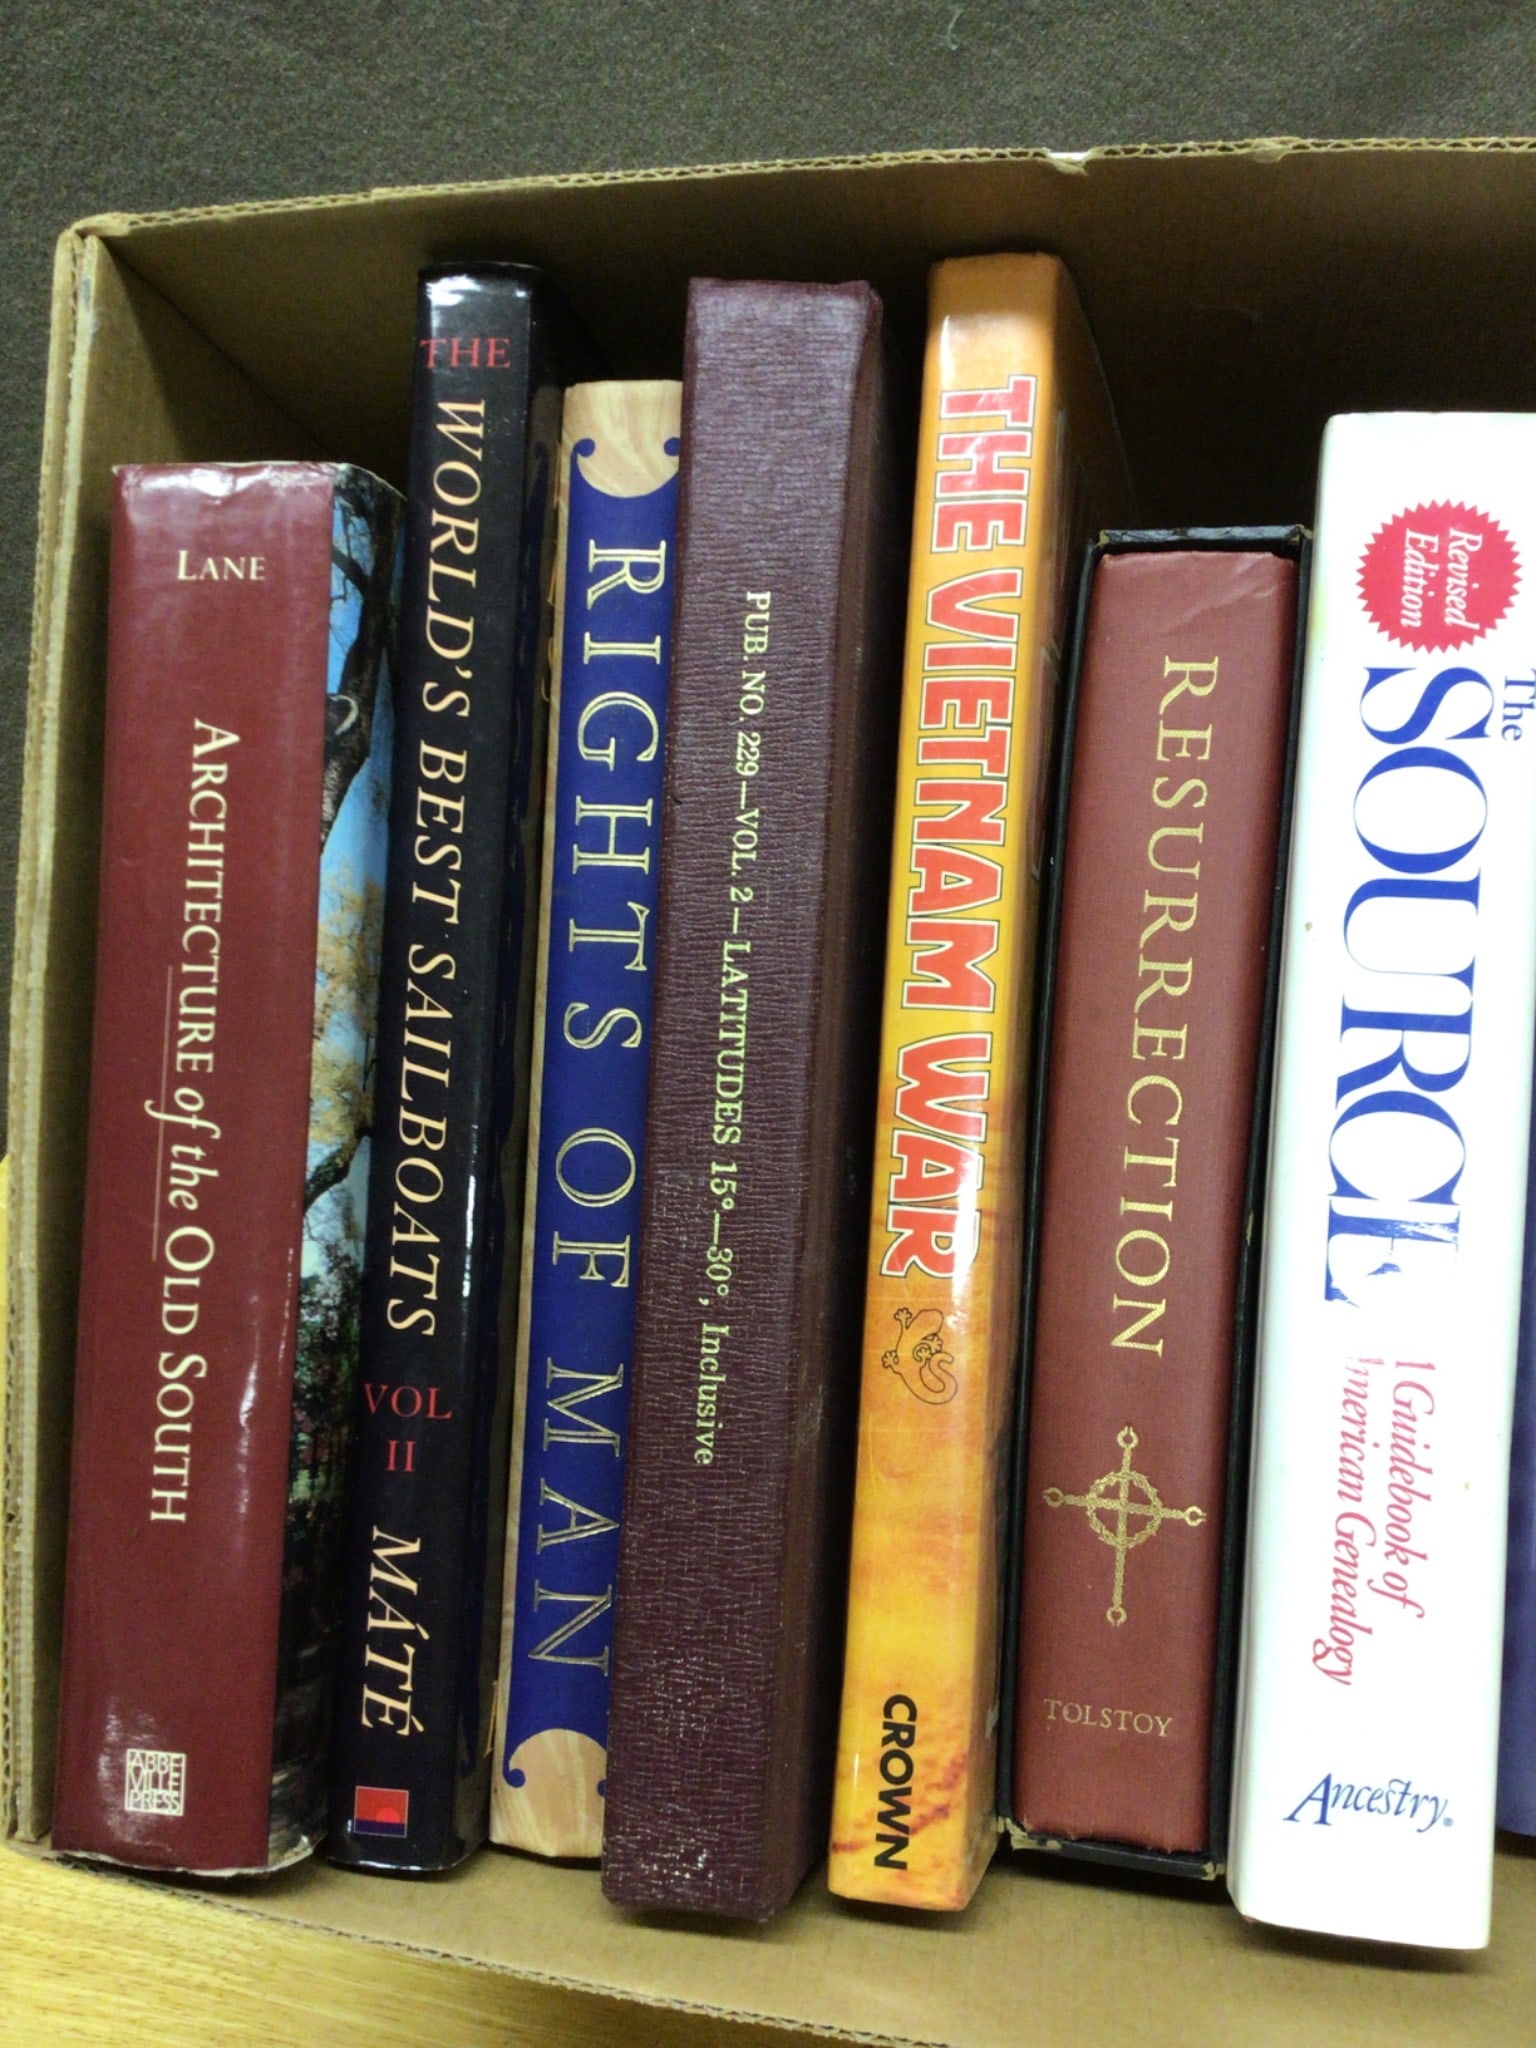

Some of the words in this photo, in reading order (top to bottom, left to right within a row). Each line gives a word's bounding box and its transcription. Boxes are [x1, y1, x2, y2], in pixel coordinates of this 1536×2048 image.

[421, 338, 511, 369] THE
[931, 374, 1037, 554] THE
[742, 590, 771, 662] PUB.
[1400, 527, 1440, 629] Edition
[1443, 527, 1483, 631] Revised
[738, 670, 766, 722] NO.
[1501, 668, 1536, 741] The
[411, 738, 468, 926] BEST
[564, 539, 667, 1049] RIGHTS
[900, 567, 1023, 1014] VIETNAM
[175, 717, 241, 1074] ARCHITECTURE
[1111, 655, 1220, 1358] RESURRECTION
[144, 1087, 221, 1139] of
[167, 1143, 219, 1211] the
[386, 943, 456, 1337] SAILBOATS
[881, 1031, 993, 1279] WAR
[160, 1226, 216, 1337] OLD
[551, 1127, 637, 1288] OF
[150, 1352, 208, 1523] SOUTH
[363, 1382, 453, 1421] VOL
[385, 1440, 415, 1472] II
[694, 1322, 730, 1466] Inclusive
[528, 1357, 624, 1677] MAN
[1382, 1380, 1436, 1566] Guidebook
[1311, 1511, 1378, 1687] Genealogy
[1367, 1570, 1426, 1618] of
[873, 1693, 918, 1871] CROWN
[1044, 1699, 1173, 1738] TOLSTOY
